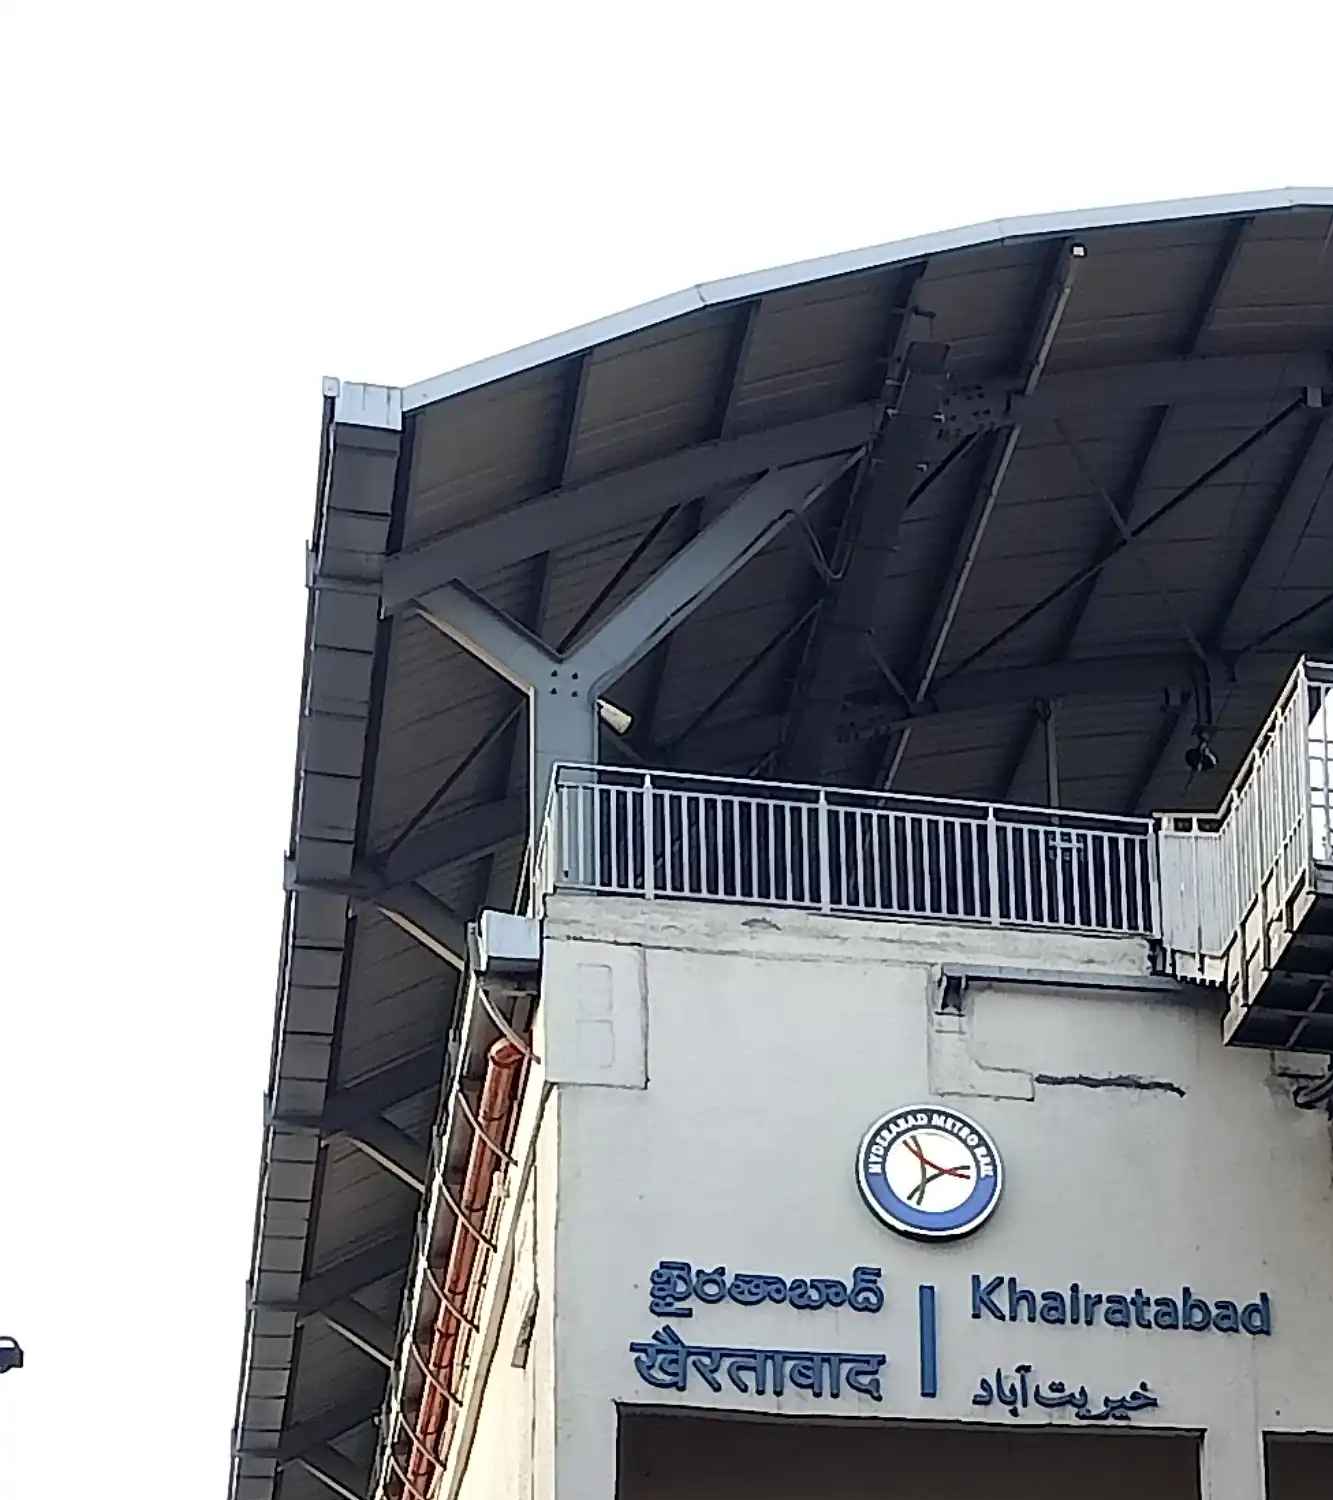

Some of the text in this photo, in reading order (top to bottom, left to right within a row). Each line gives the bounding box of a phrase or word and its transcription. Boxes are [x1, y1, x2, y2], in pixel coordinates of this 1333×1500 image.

[868, 1113, 928, 1174] HYDERABAD
[932, 1113, 979, 1147] METRO
[649, 1261, 884, 1318] ఖైరతాబాద్
[970, 1274, 1272, 1336] Khairatabad
[629, 1324, 887, 1402] खैरताबाद
